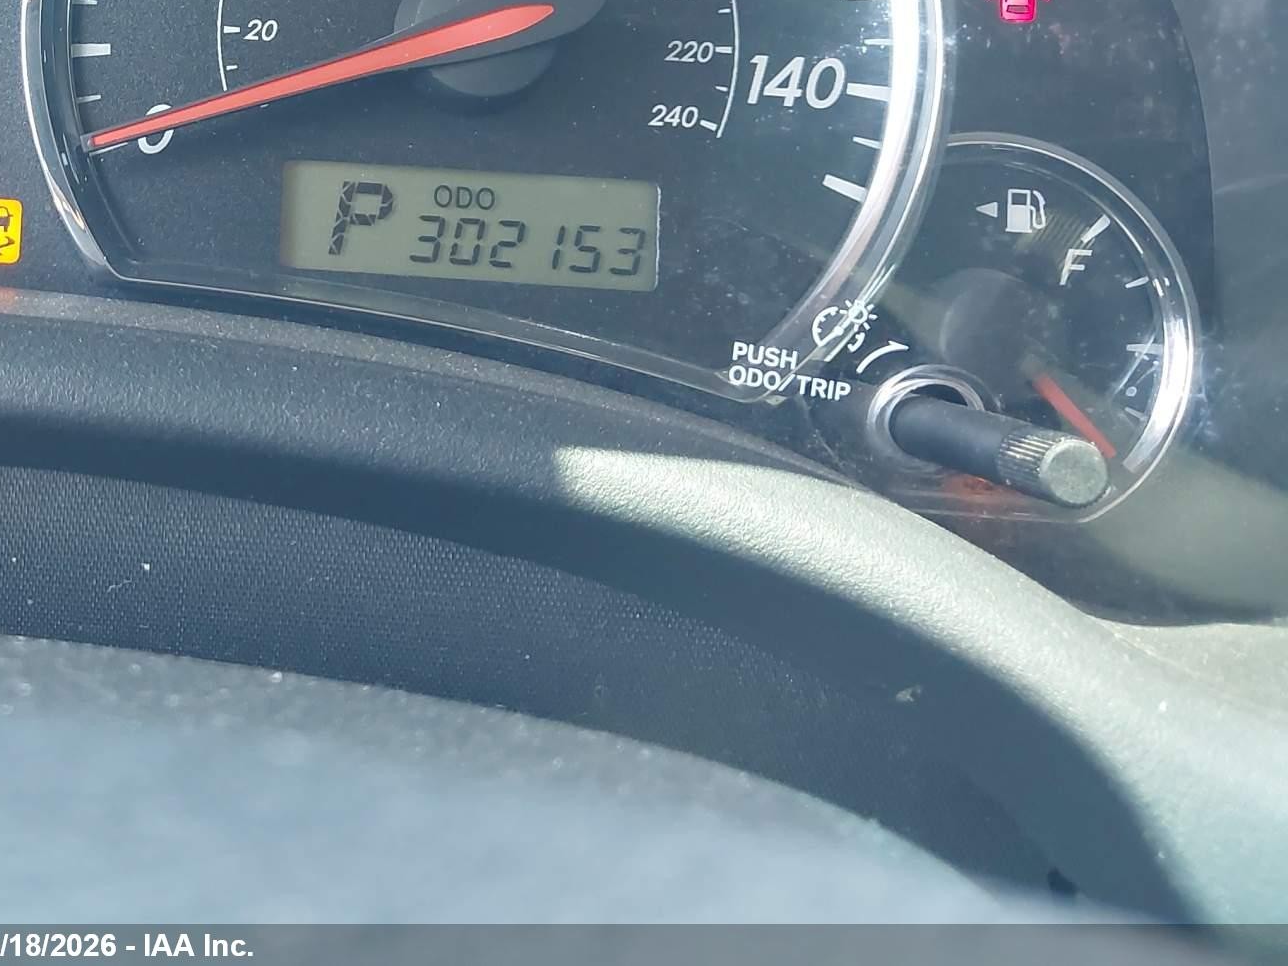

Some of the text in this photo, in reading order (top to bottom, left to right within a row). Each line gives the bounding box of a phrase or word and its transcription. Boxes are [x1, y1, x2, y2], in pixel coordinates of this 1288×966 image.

[243, 19, 278, 42] 20
[664, 41, 713, 63] 220
[747, 54, 846, 109] 140
[648, 105, 698, 128] 240
[434, 185, 496, 209] ODO
[328, 181, 395, 255] P
[410, 215, 646, 275] 302153
[1059, 249, 1092, 285] F
[732, 342, 798, 370] PUSH
